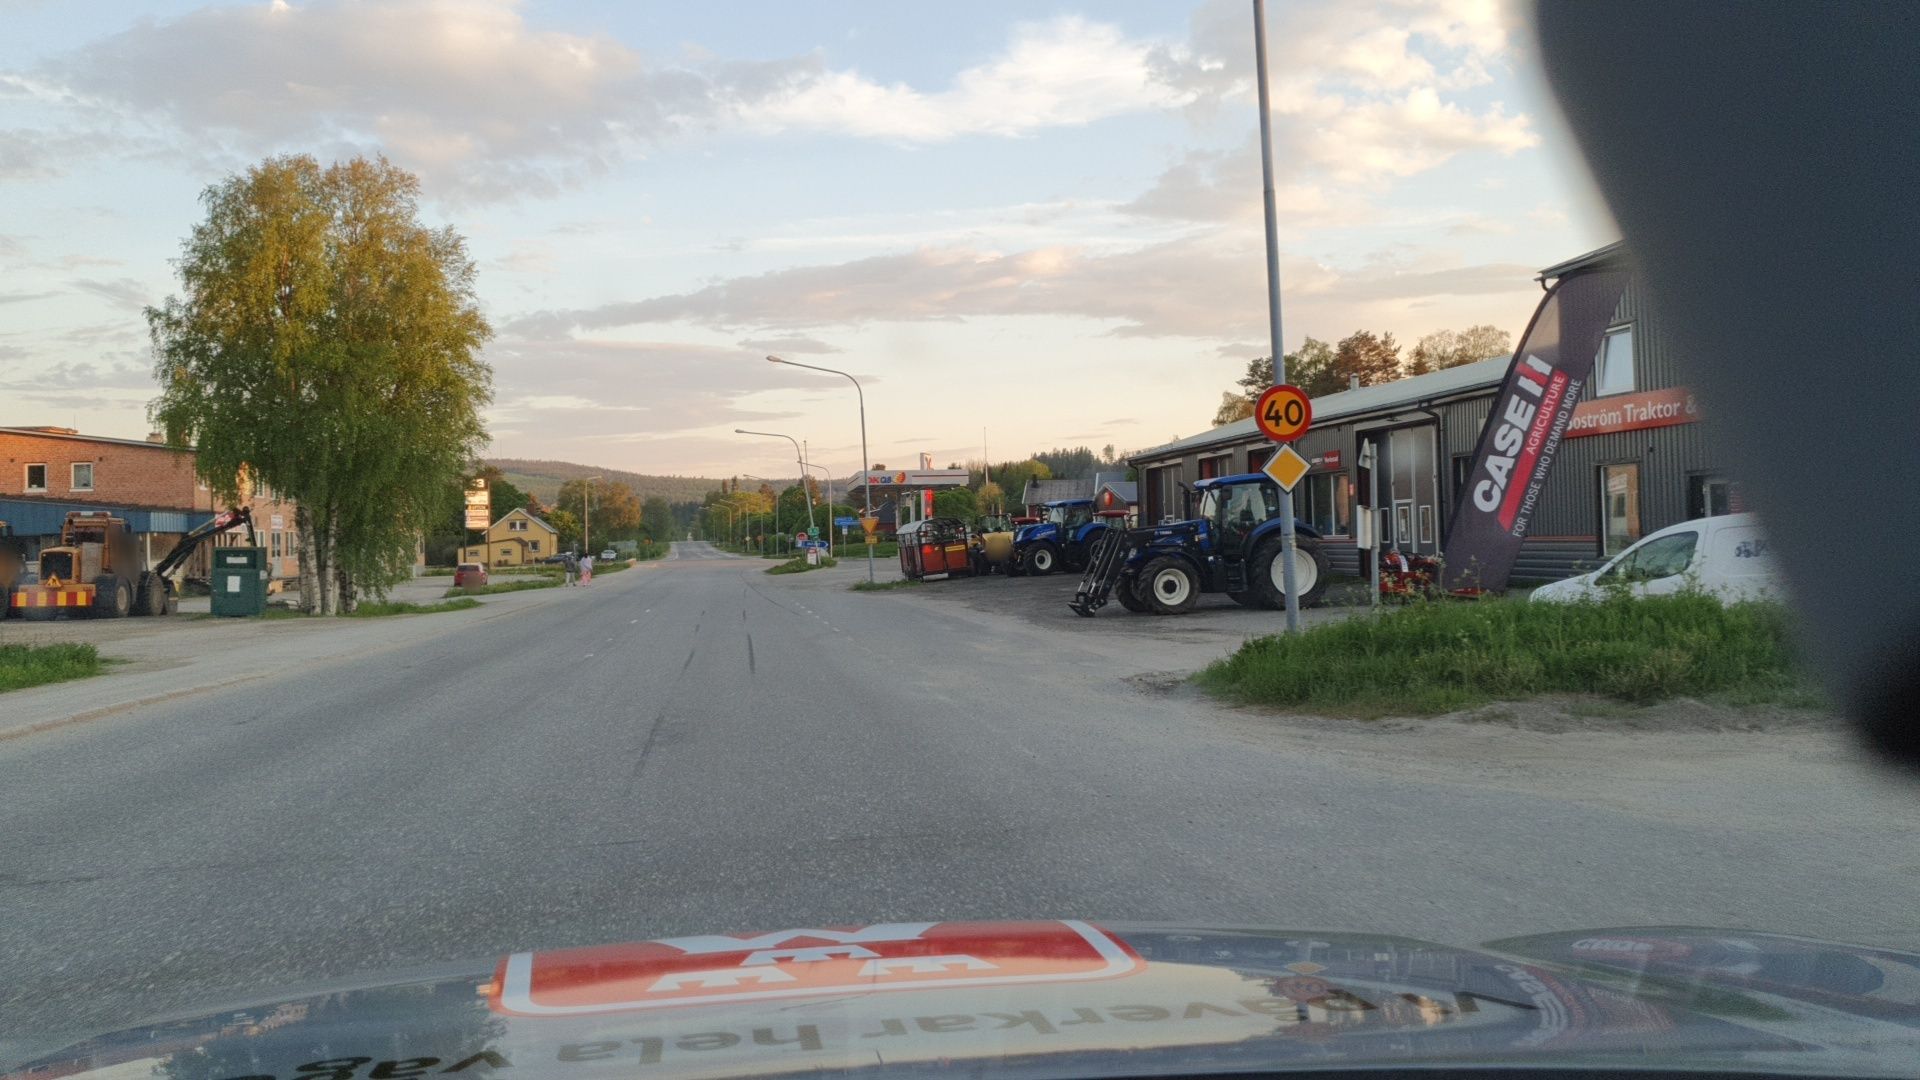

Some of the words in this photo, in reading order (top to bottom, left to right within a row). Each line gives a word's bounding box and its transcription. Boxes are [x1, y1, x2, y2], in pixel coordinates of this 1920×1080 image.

[1264, 399, 1304, 427] 40
[1525, 374, 1566, 456] AGRICULTURE
[1624, 401, 1680, 423] Traktor
[1684, 394, 1698, 415] &
[1473, 395, 1535, 512] CASE
[1512, 516, 1530, 538] FOR
[1521, 483, 1542, 517] THOSE
[1533, 454, 1552, 482] WHO
[1545, 411, 1569, 456] DEMAND
[1562, 379, 1583, 412] MORE
[557, 1021, 822, 1065] hela
